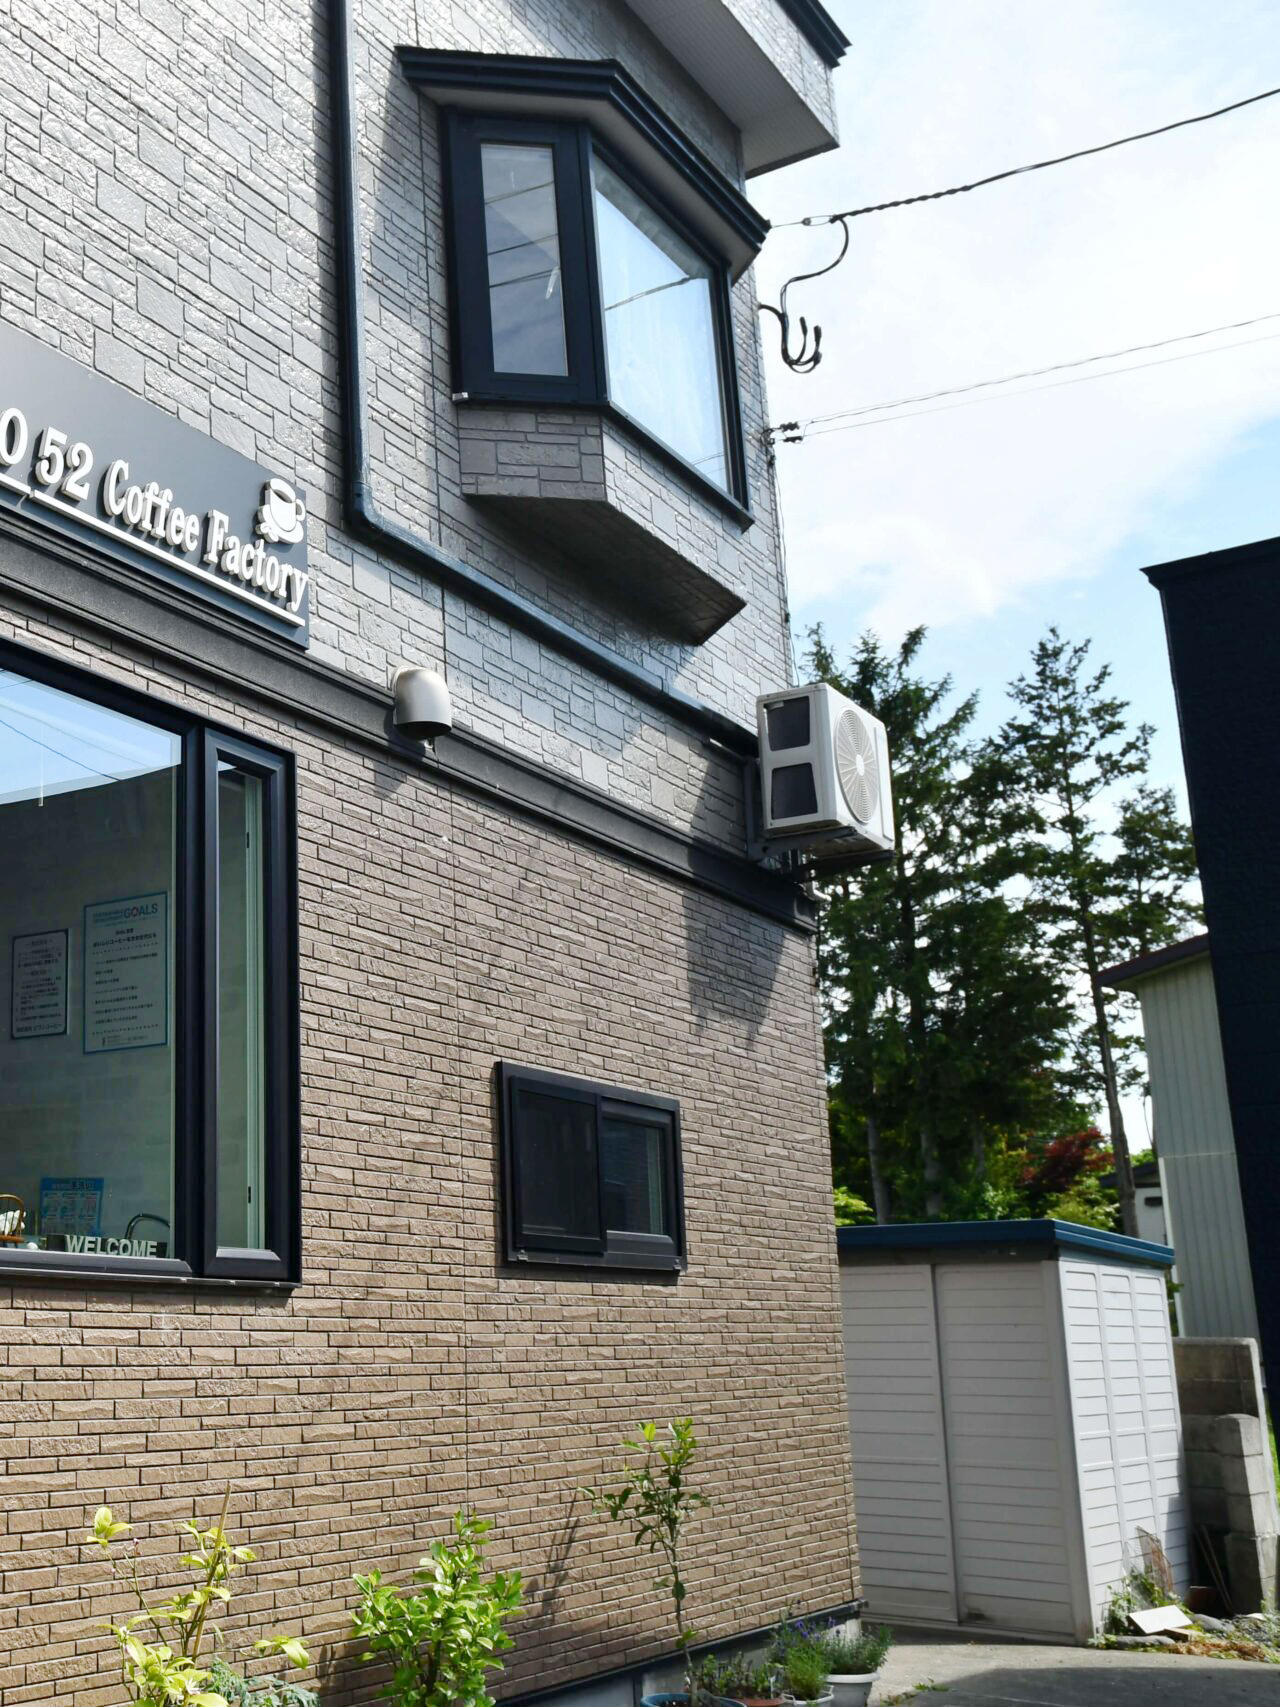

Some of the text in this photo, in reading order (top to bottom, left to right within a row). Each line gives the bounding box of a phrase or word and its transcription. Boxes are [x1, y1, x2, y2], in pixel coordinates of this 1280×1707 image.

[35, 425, 95, 501] 52
[103, 459, 200, 553] Coffee
[203, 508, 310, 613] Factory
[123, 903, 158, 919] GOALS
[65, 1234, 158, 1258] WELCOME
